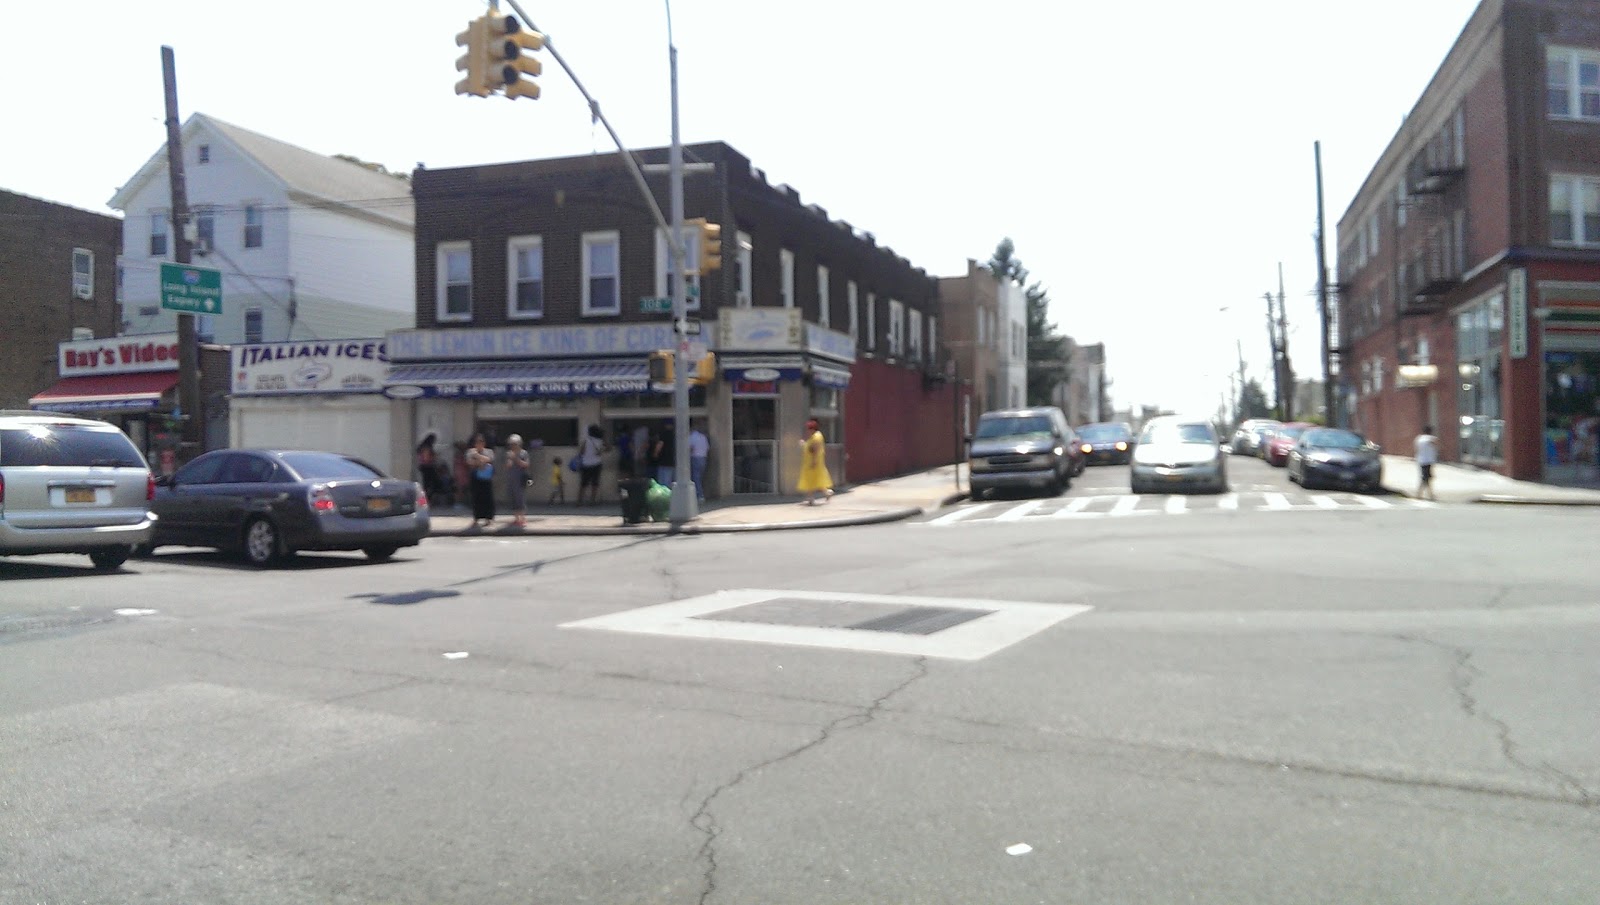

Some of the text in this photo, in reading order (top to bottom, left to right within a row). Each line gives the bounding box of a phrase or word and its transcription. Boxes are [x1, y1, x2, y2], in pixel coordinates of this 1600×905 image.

[163, 281, 220, 298] Long Island
[391, 334, 423, 355] THE
[430, 332, 496, 354] LEMON
[503, 330, 530, 352] ICE
[540, 328, 587, 352] KING
[594, 327, 617, 350] OF
[626, 326, 714, 351] COROA
[65, 342, 179, 368] Ray's Video
[240, 343, 388, 368] ITALIAN ICES
[437, 384, 460, 395] THE
[466, 383, 506, 394] LEMON
[513, 382, 533, 393] ICE
[540, 381, 570, 392] KING
[574, 381, 590, 392] OF
[594, 380, 648, 391] CORONA
